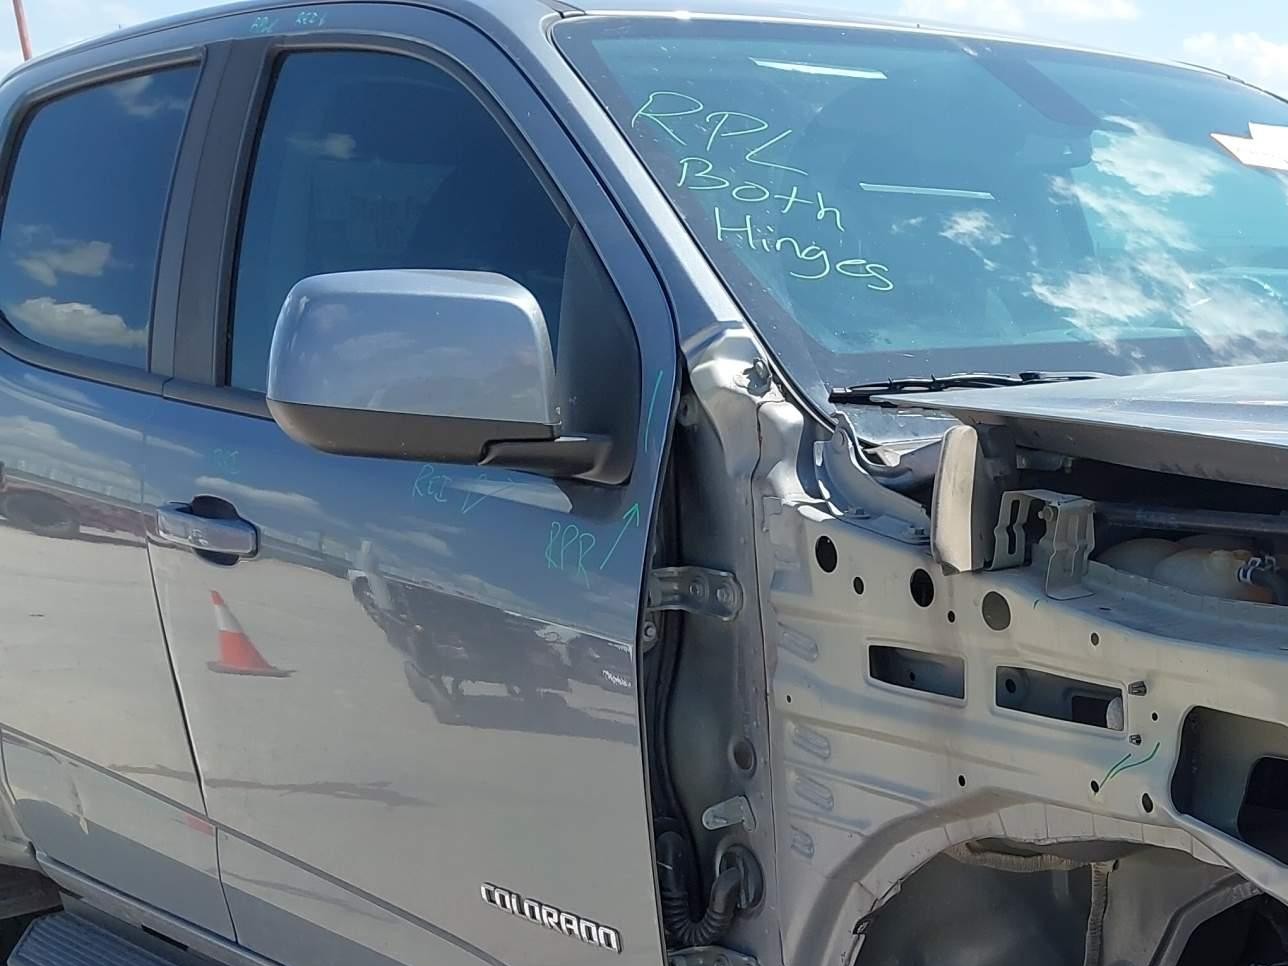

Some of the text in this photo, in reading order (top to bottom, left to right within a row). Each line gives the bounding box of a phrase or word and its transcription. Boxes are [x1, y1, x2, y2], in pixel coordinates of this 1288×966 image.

[677, 157, 845, 233] Both
[714, 207, 894, 291] Hinges
[480, 881, 624, 955] COLORADO
